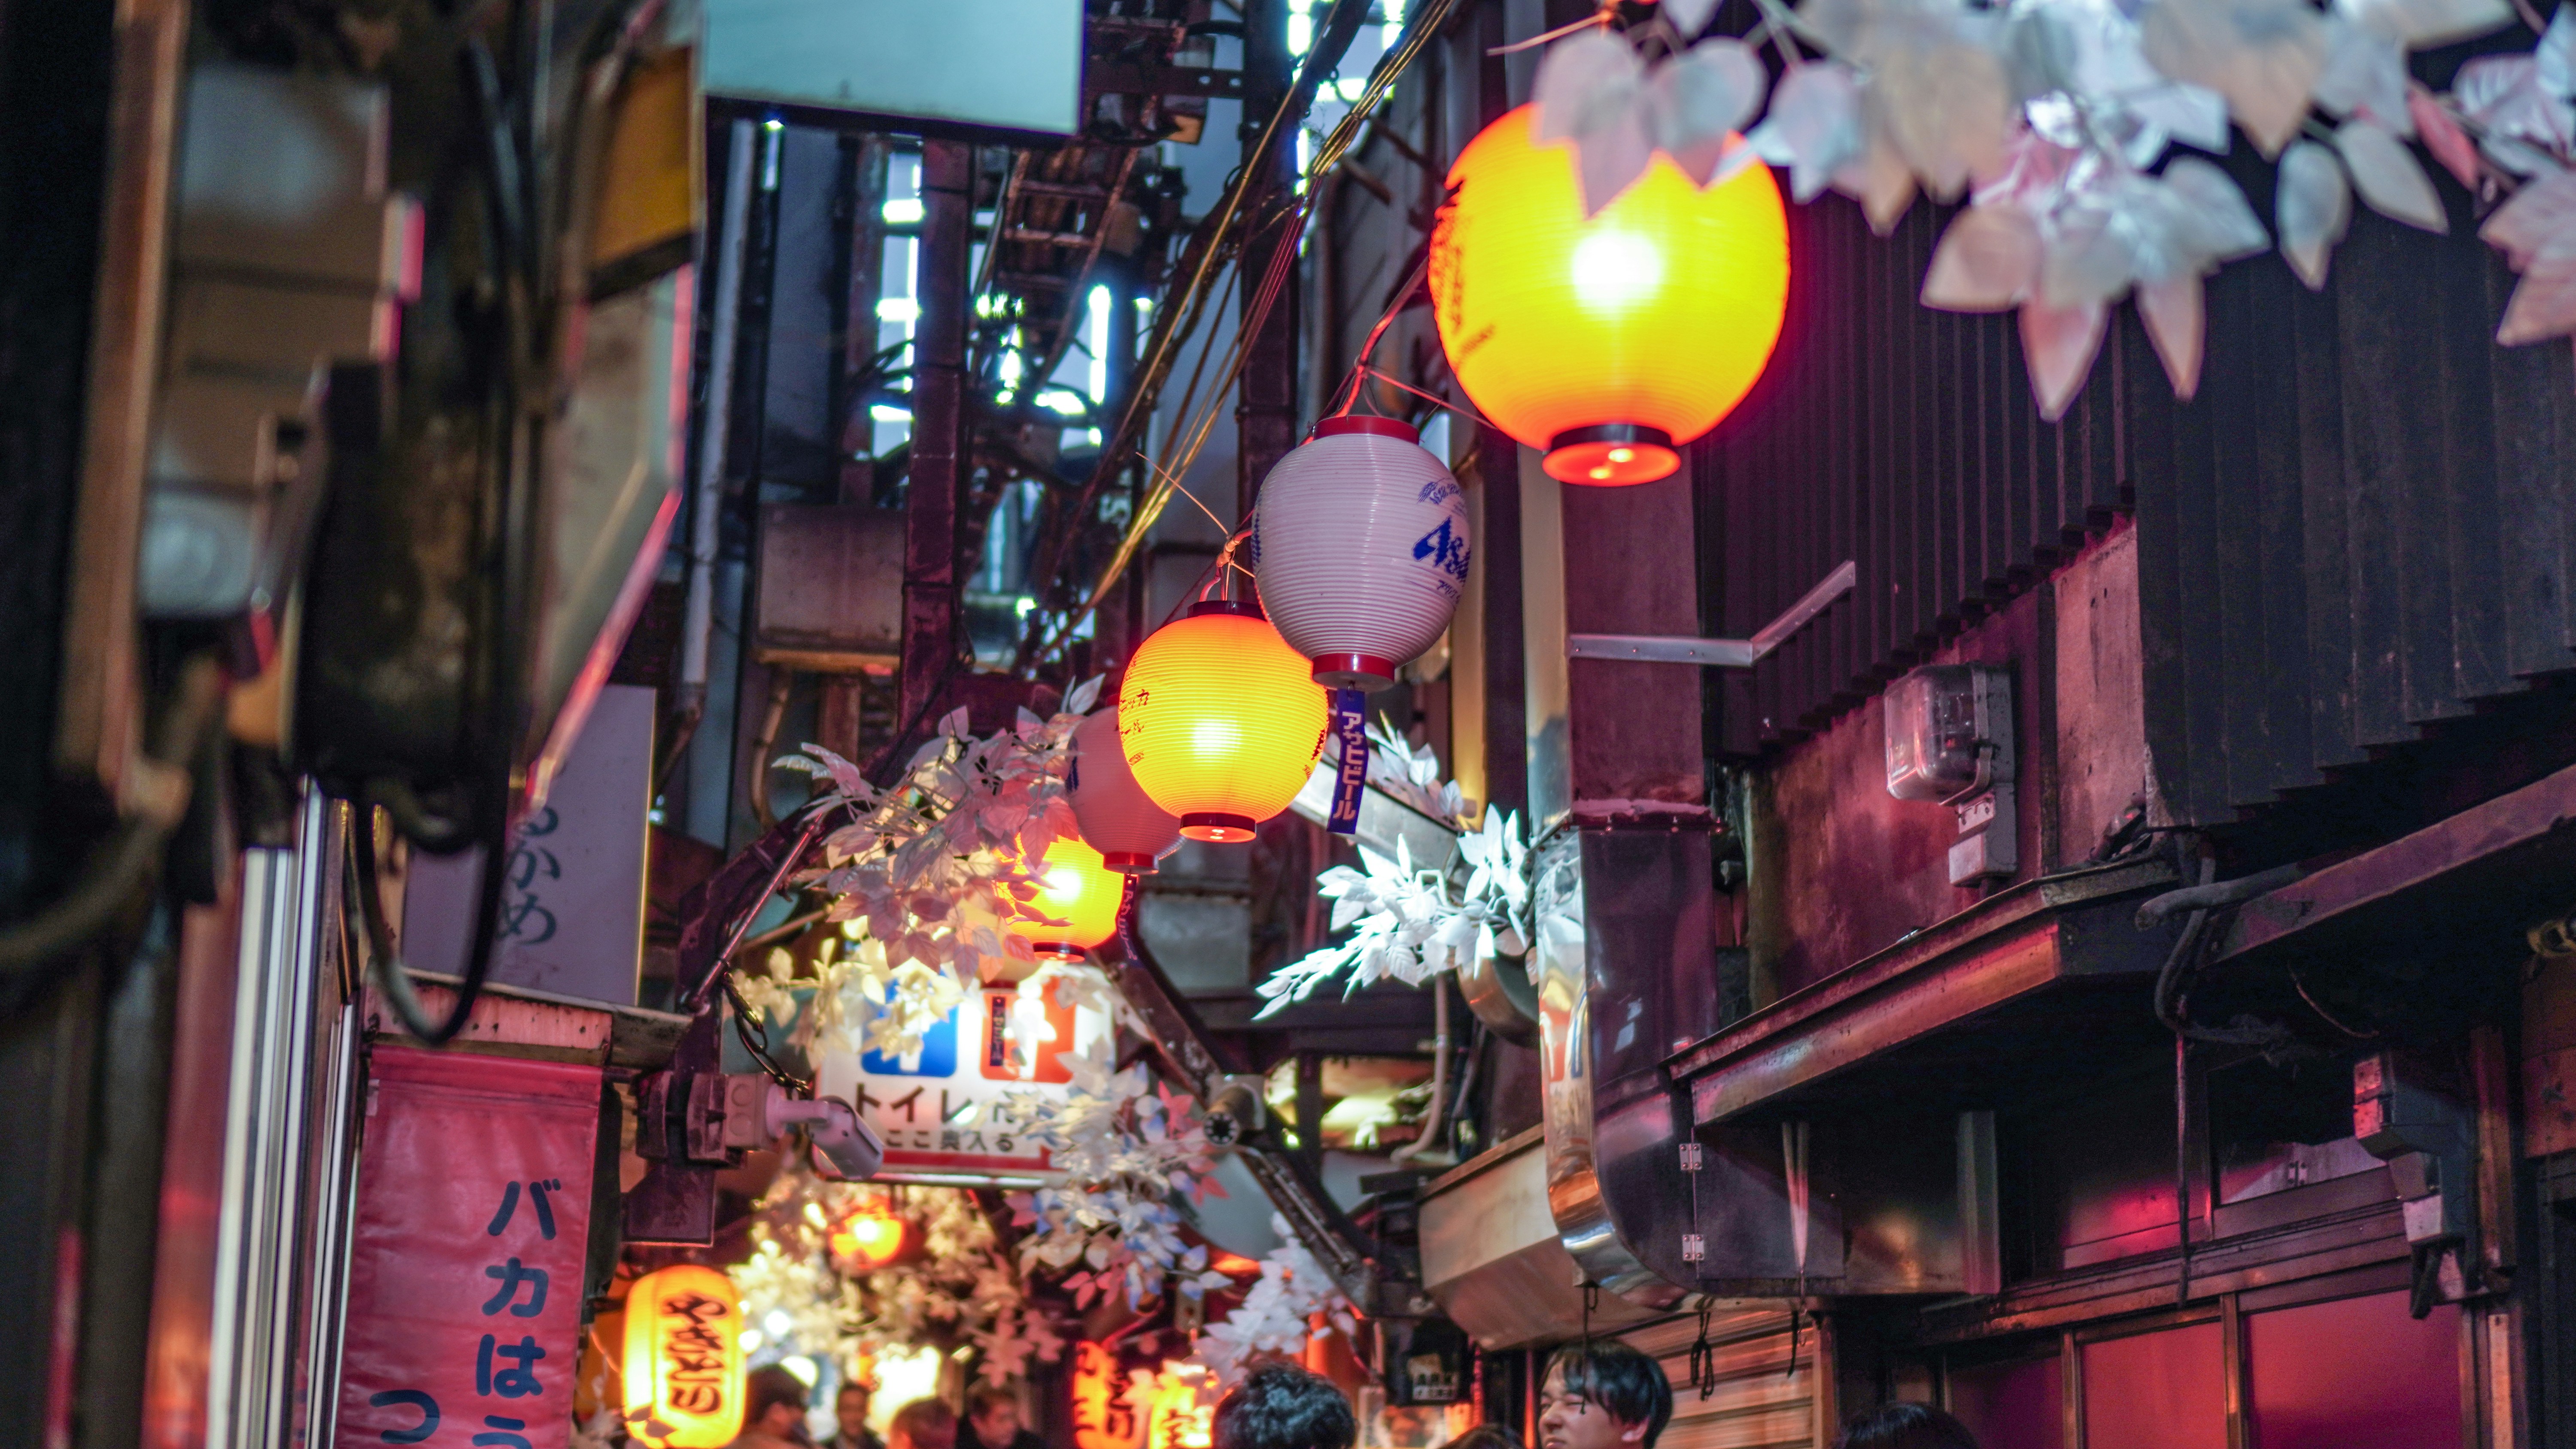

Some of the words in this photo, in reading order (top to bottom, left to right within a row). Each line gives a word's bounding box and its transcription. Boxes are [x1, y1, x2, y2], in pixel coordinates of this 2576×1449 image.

[1332, 711, 1364, 820] アサヒビール
